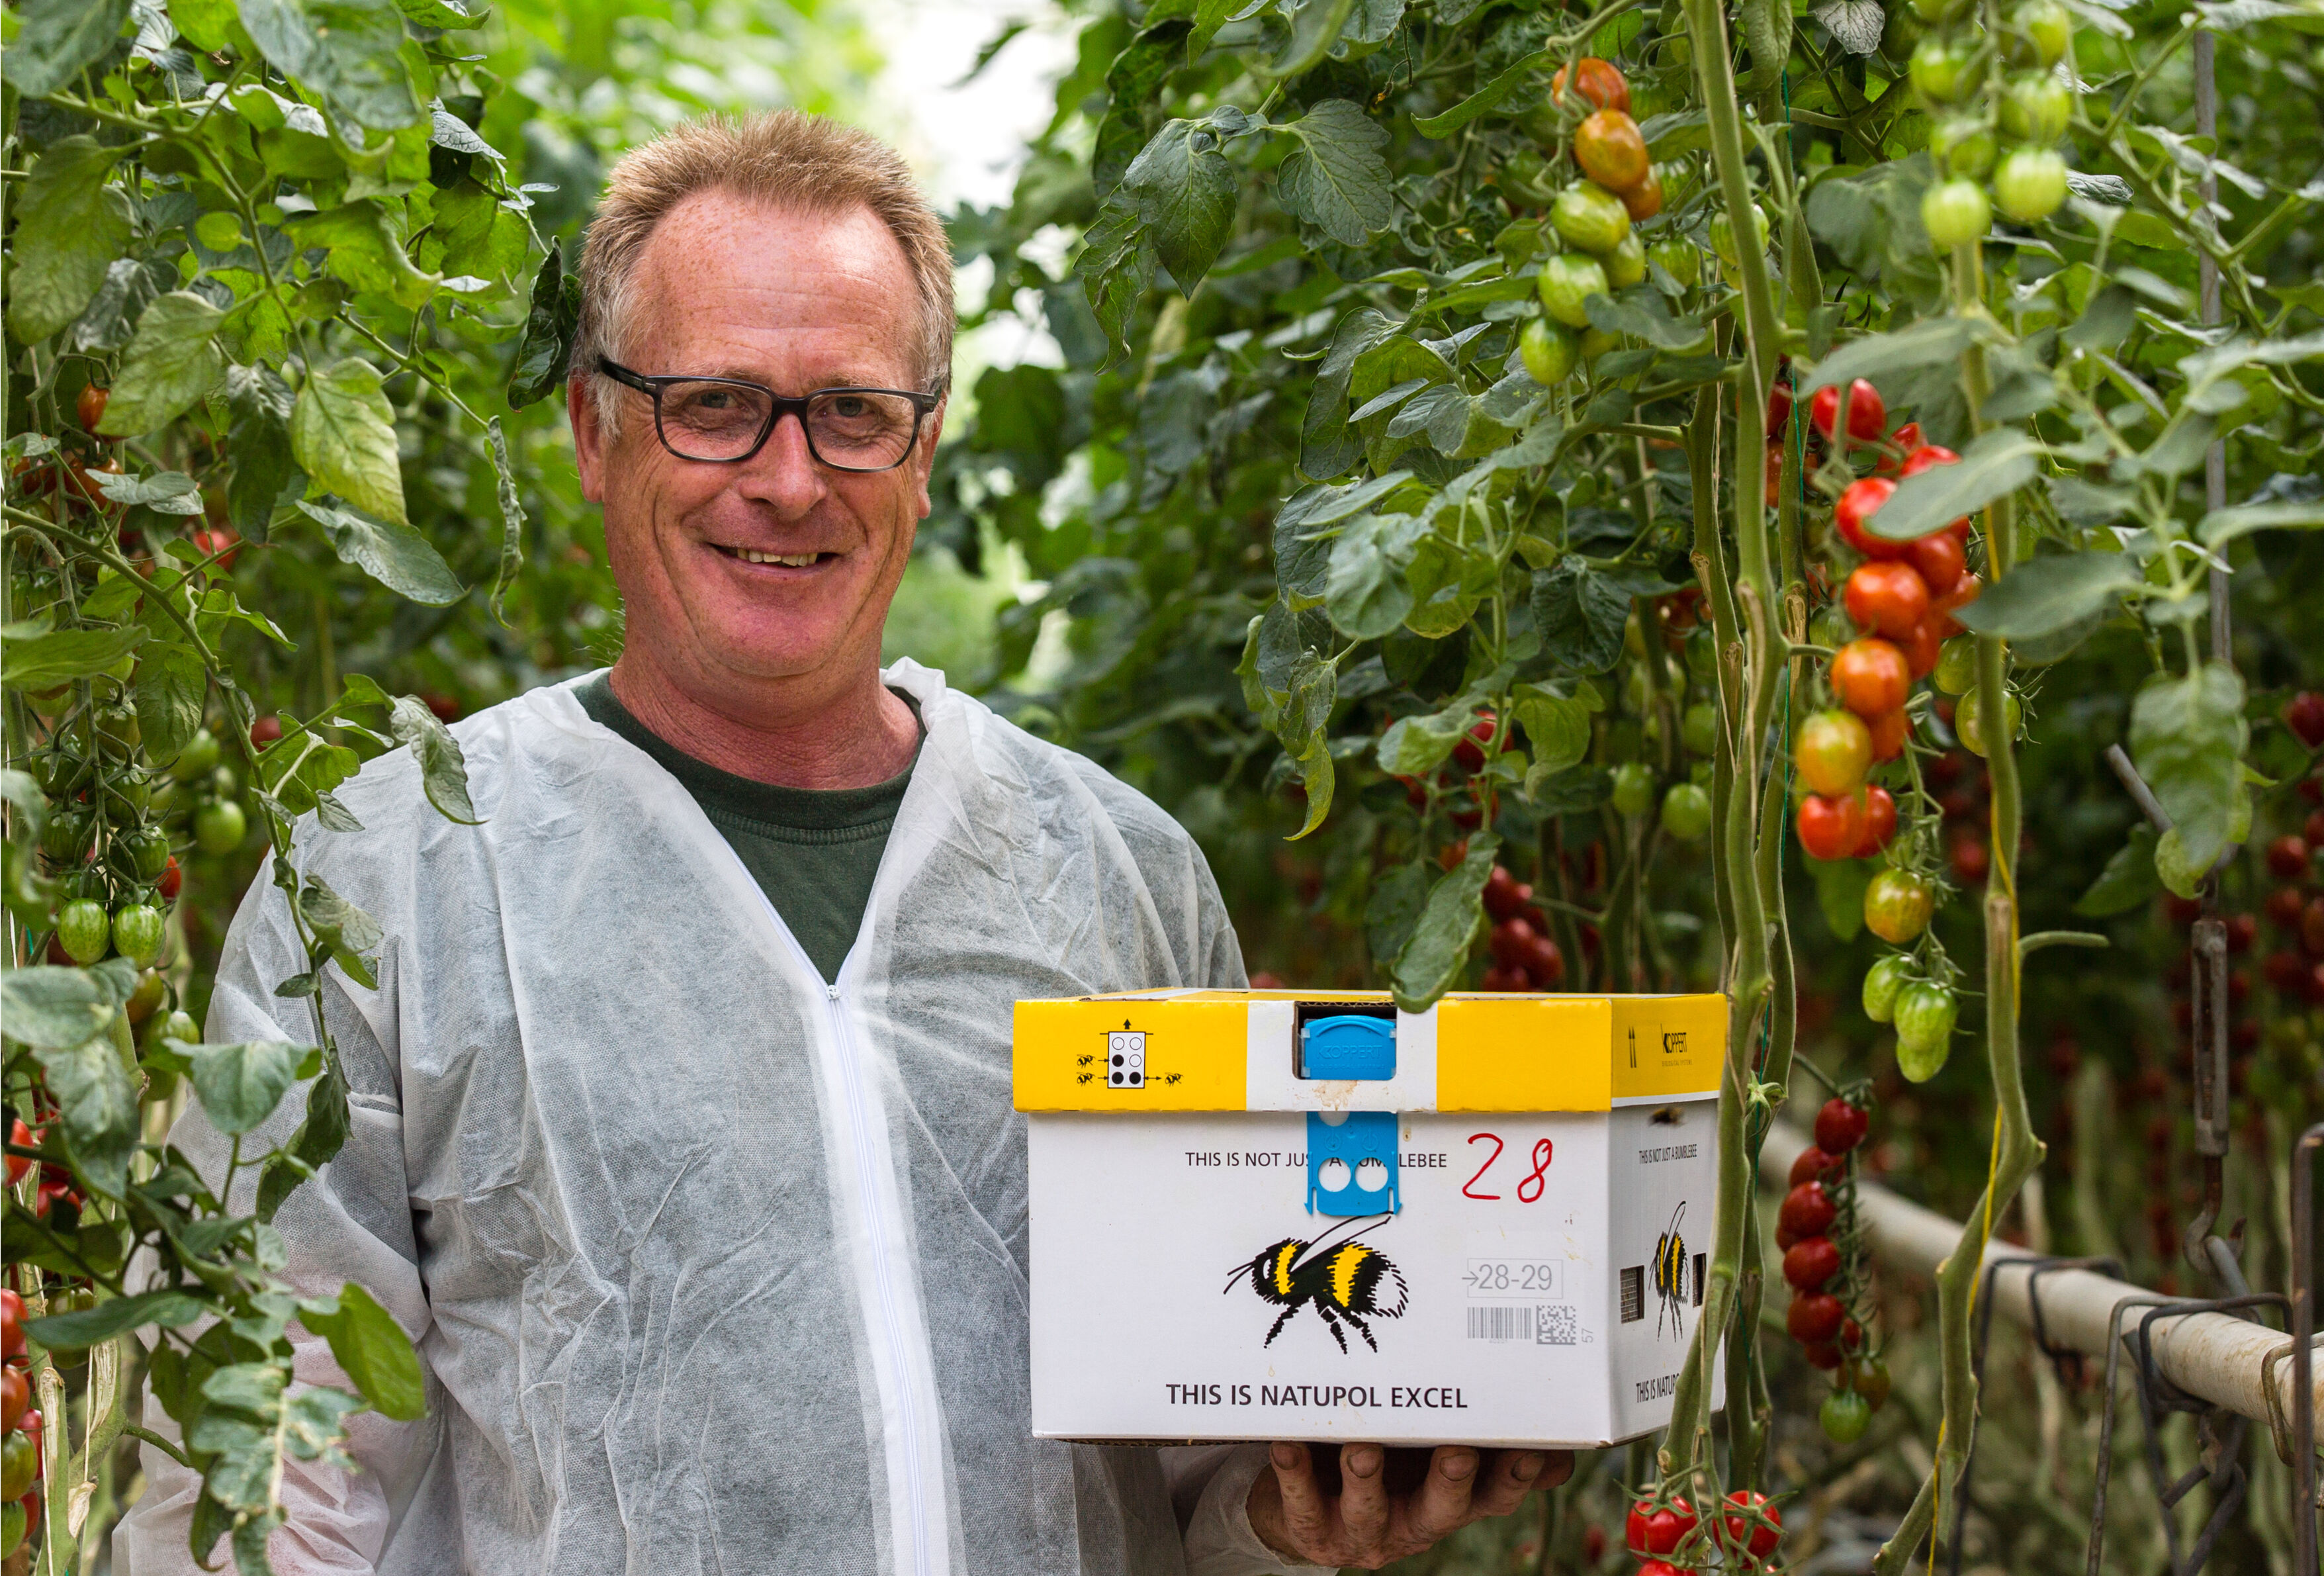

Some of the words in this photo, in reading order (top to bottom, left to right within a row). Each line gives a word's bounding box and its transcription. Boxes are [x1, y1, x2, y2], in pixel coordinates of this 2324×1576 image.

[1185, 1152, 1221, 1167] THIS
[1227, 1152, 1239, 1167] IS
[1245, 1152, 1281, 1168] NOT
[1285, 1153, 1308, 1168] JU
[1329, 1157, 1342, 1168] A
[1350, 1154, 1447, 1168] UMLEBEE
[1462, 1133, 1553, 1203] 28
[1478, 1264, 1552, 1291] 28-29
[1582, 1328, 1593, 1344] 57
[1165, 1383, 1222, 1405] THIS
[1231, 1385, 1252, 1406] IS
[1261, 1385, 1382, 1407] NATUPOL
[1391, 1387, 1468, 1409] EXCEL
[1636, 1380, 1649, 1403] THIS
[1650, 1378, 1656, 1400] IS
[1656, 1373, 1679, 1399] NATUP
